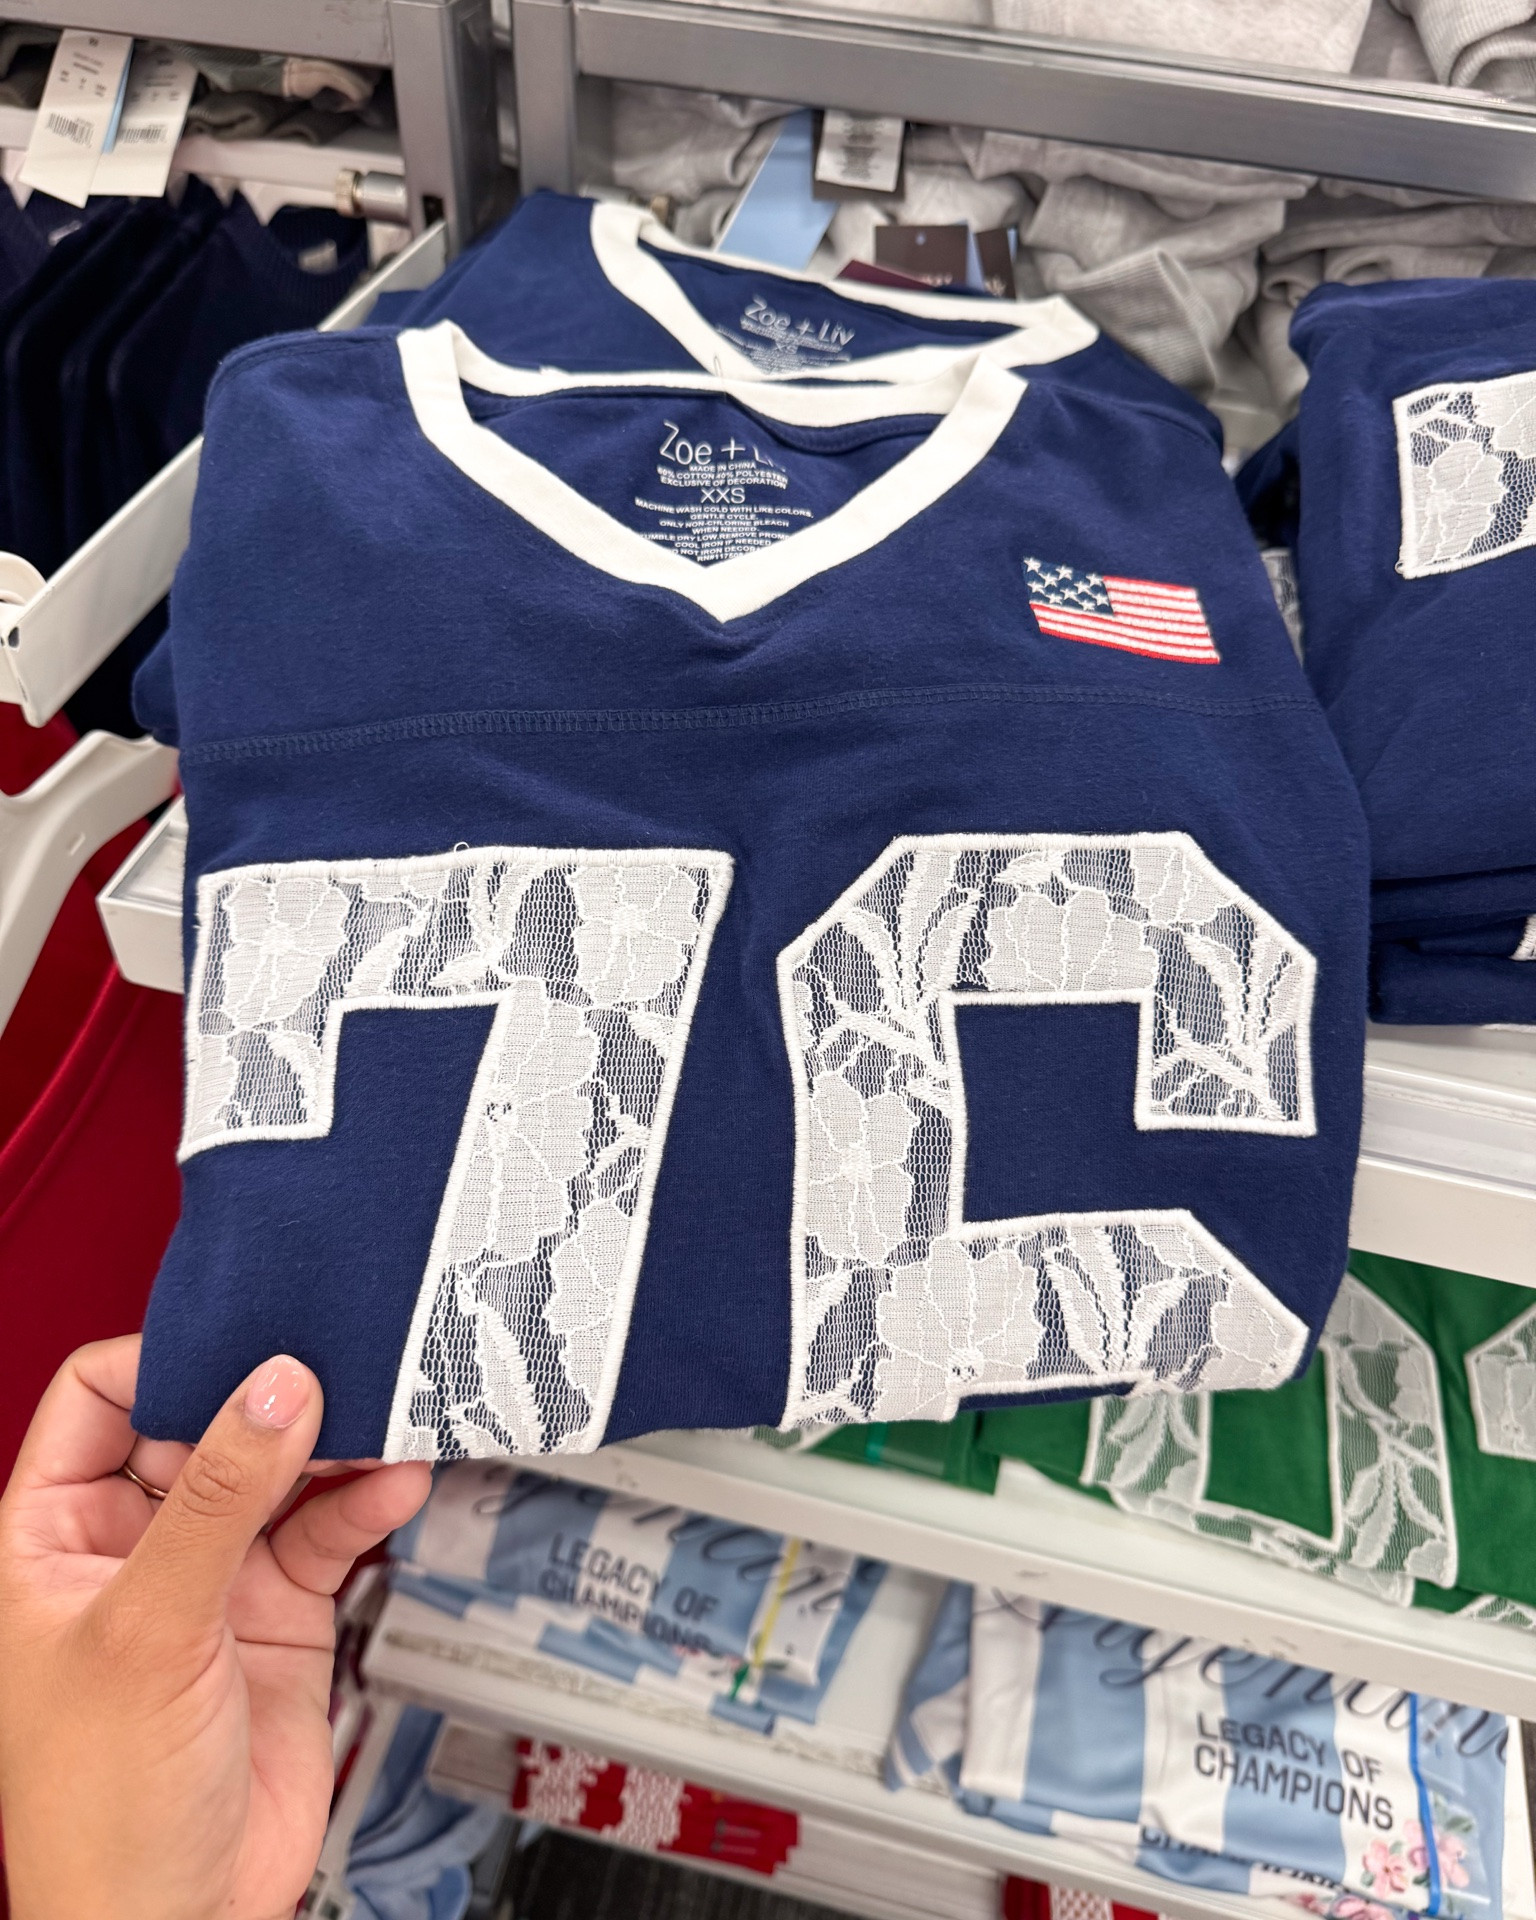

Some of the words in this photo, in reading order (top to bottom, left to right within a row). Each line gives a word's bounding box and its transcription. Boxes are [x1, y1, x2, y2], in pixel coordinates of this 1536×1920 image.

[744, 295, 790, 331] Zoe
[660, 419, 712, 465] Zoe
[721, 436, 746, 460] +
[689, 463, 715, 472] MADE
[717, 462, 726, 471] IN
[728, 461, 757, 471] CHINA
[660, 475, 711, 487] EXCLUSIVE
[712, 479, 725, 487] OF
[727, 477, 787, 490] DECORATION
[677, 471, 715, 480] COTTON
[735, 469, 788, 484] POLYESTER
[700, 487, 746, 504] XXS
[635, 496, 675, 514] MACHINE
[675, 505, 702, 514] WASH
[703, 505, 728, 513] COLD
[729, 505, 752, 513] WITH
[753, 505, 774, 514] LIKE
[774, 507, 814, 518] COLORS.
[659, 519, 684, 528] ONLY
[685, 519, 752, 528] NON-CHLORINE
[753, 518, 789, 527] BLEACH
[691, 526, 718, 535] WHEN
[675, 541, 700, 549] COOL
[701, 540, 724, 549] IRON
[676, 534, 696, 542] DRY
[680, 548, 699, 556] NOT
[700, 547, 723, 557] IRON
[548, 1532, 670, 1604] LEGACY
[673, 1585, 720, 1621] OF
[1196, 1712, 1326, 1767] LEGACY
[1341, 1748, 1382, 1784] OF
[1194, 1742, 1394, 1830] CHAMPIONS
